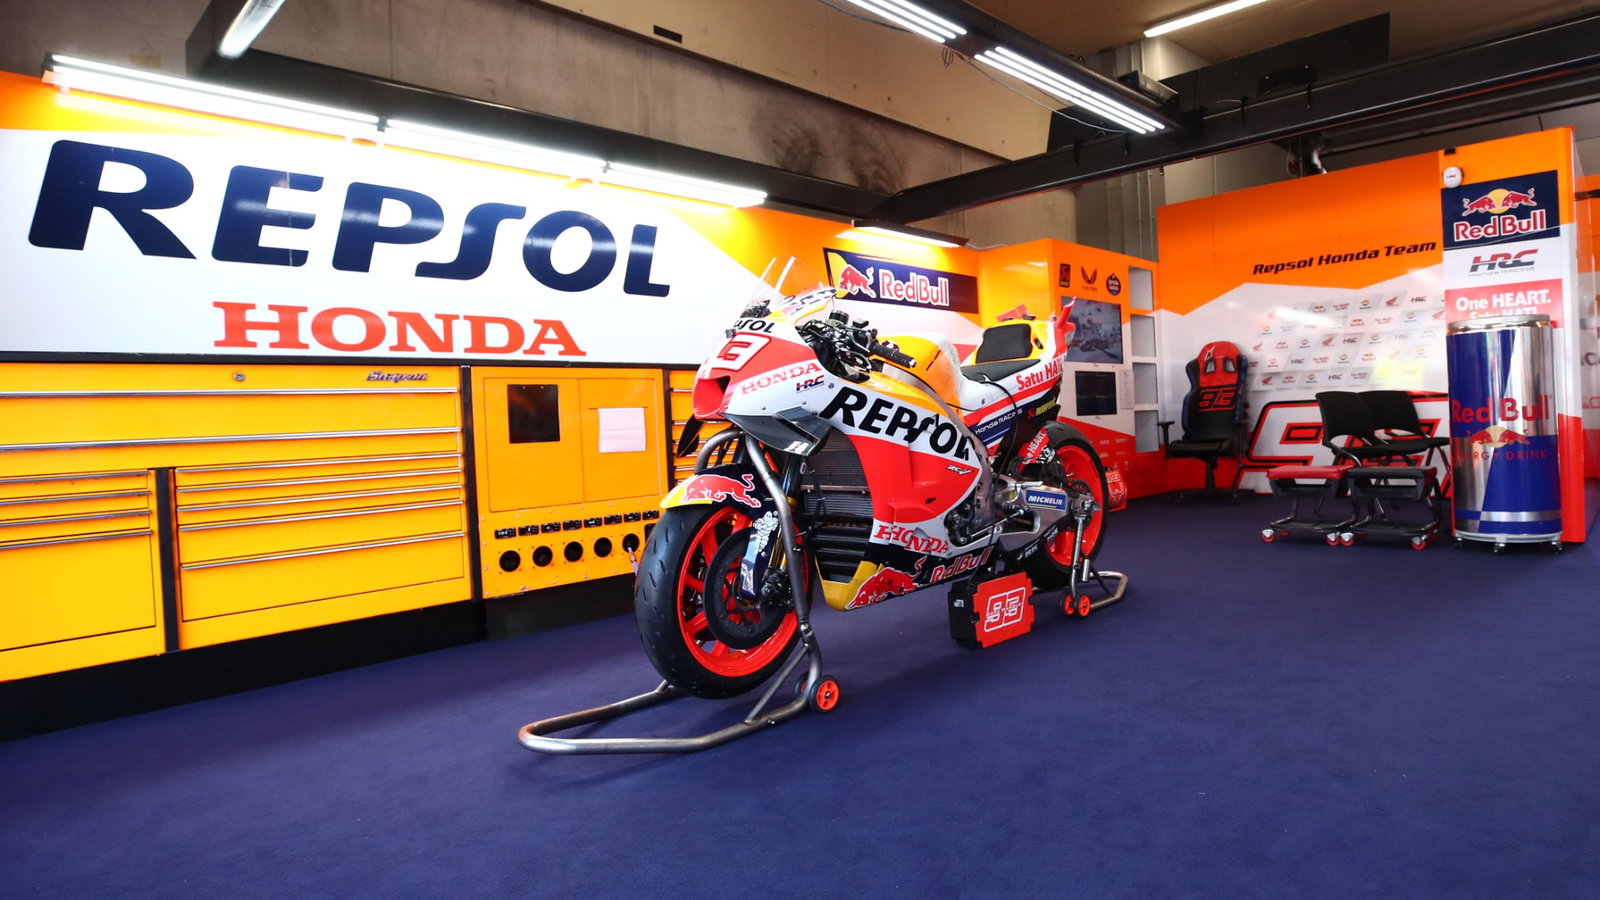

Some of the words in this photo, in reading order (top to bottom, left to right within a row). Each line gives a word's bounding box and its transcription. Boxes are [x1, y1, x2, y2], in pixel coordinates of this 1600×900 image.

[28, 139, 670, 298] REPSOL
[1454, 215, 1500, 242] Red
[1501, 209, 1547, 236] Bull
[1252, 257, 1313, 275] Repsol
[1317, 249, 1380, 266] Honda
[1383, 241, 1437, 257] Team
[1470, 249, 1539, 273] HRC
[878, 268, 918, 303] Red
[917, 274, 949, 307] Bull
[1455, 297, 1488, 312] One
[1492, 289, 1552, 308] HEART.
[212, 301, 587, 356] HONDA
[741, 362, 823, 396] HONDA
[796, 375, 825, 391] HRC
[1015, 371, 1044, 391] Satu
[819, 386, 970, 461] REPSOL
[1451, 397, 1494, 423] Red
[1500, 395, 1549, 421] Bull
[974, 420, 999, 435] Honda
[1506, 450, 1547, 460] DRINK
[1028, 495, 1063, 505] MICHELIN
[874, 524, 949, 554] HONDA
[954, 545, 994, 576] Bull
[984, 586, 1026, 632] 93
